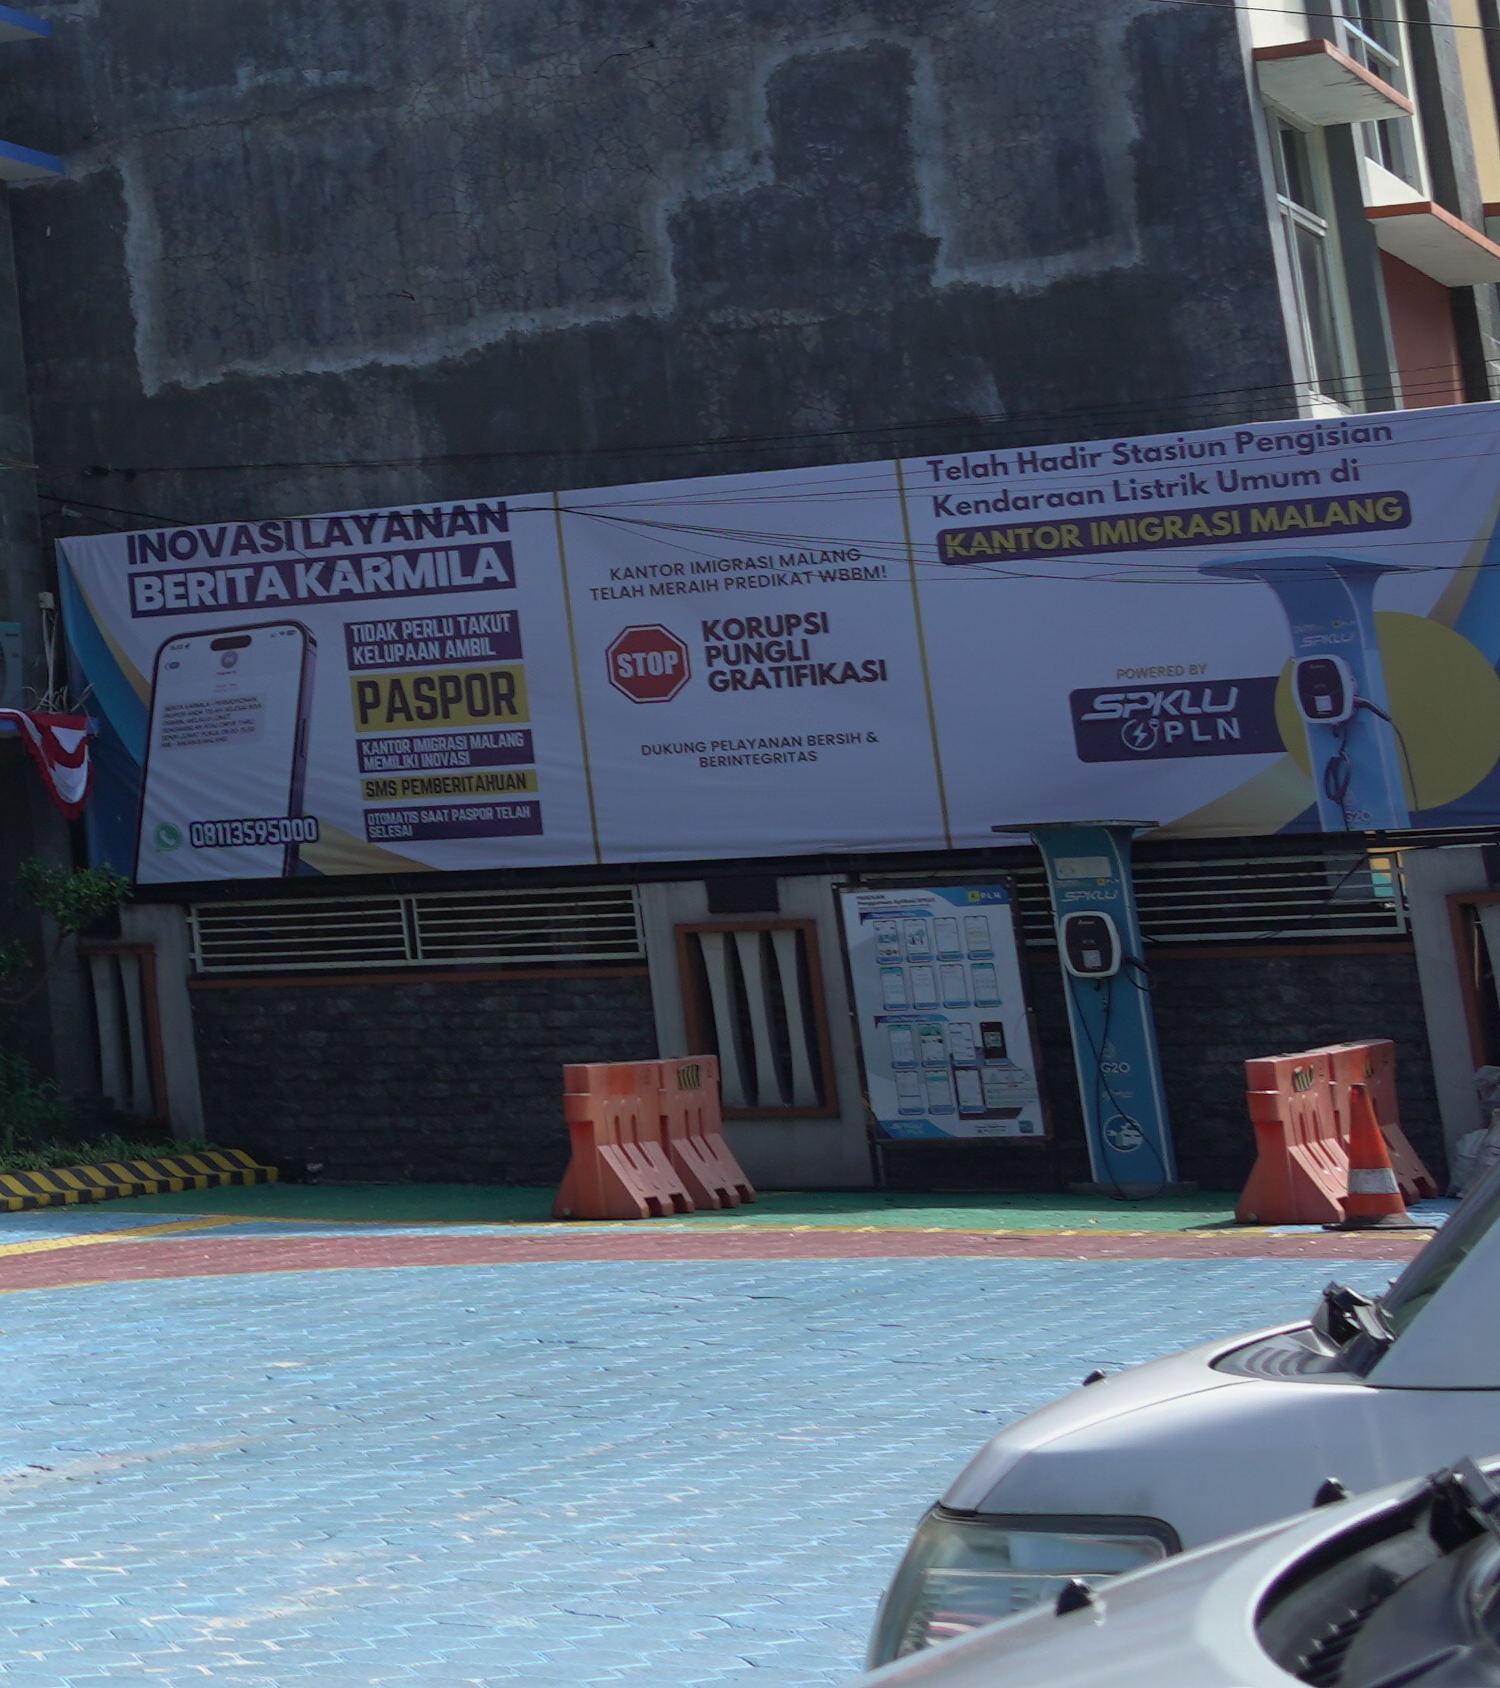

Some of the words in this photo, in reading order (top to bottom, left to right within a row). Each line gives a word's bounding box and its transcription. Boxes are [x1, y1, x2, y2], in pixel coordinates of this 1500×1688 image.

[927, 453, 1009, 483] Telah
[1016, 446, 1103, 476] Hadir
[1111, 437, 1227, 467] Stasiun
[1234, 421, 1393, 456] Pengisian
[932, 486, 1106, 519] Kendaraan
[1112, 472, 1210, 503] Listrik
[1215, 466, 1321, 495] Umum
[1329, 458, 1361, 483] di
[127, 521, 295, 565] INOVASI
[302, 501, 510, 551] LAYANAN
[943, 524, 1085, 559] KANTOR
[1090, 510, 1242, 545] IMIGRASI
[1250, 495, 1405, 534] MALANG
[132, 563, 291, 612] BERITA
[296, 546, 510, 598] KARMILA
[610, 562, 685, 581] KANTOR
[690, 555, 775, 576] IMIGRASI
[779, 548, 861, 568] MALANG
[590, 581, 645, 601] TELAH
[650, 577, 719, 597] MERAIH
[724, 570, 813, 591] PREDIKAT
[818, 565, 887, 583] WBBM!
[351, 621, 399, 644] TIDAK
[401, 617, 455, 639] PERLU
[457, 613, 511, 634] TAKUT
[701, 611, 829, 643] KORUPSI
[352, 641, 440, 665] KELUPAAN
[445, 637, 497, 659] AMBIL
[617, 650, 679, 678] STOP
[704, 638, 811, 668] PUNGLI
[708, 658, 888, 693] GRATIFIKASI
[1116, 665, 1185, 680] POWERED
[1189, 663, 1208, 676] BY
[357, 671, 518, 724] PASPOR
[1080, 686, 1239, 721] SPKLU
[362, 739, 411, 755] KANTOR
[413, 735, 468, 753] IMIGRASI
[470, 732, 525, 749] MALANG
[640, 740, 707, 757] DUKUNG
[711, 735, 802, 753] PELAYANAN
[806, 732, 862, 748] BERSIH
[865, 731, 880, 744] &
[1163, 717, 1241, 743] PLN
[363, 755, 420, 771] MEMILIKI
[421, 751, 471, 768] INOVASI
[699, 750, 818, 768] BERINTEGRITAS
[366, 780, 397, 797] SMS
[401, 772, 527, 795] PEMBERITAHUAN
[367, 811, 420, 826] OTOMATIS
[420, 809, 450, 823] SAAT
[451, 807, 493, 822] PASPOR
[495, 805, 531, 819] TELAH
[190, 817, 319, 848] 08113595000
[368, 825, 414, 839] SELESAI
